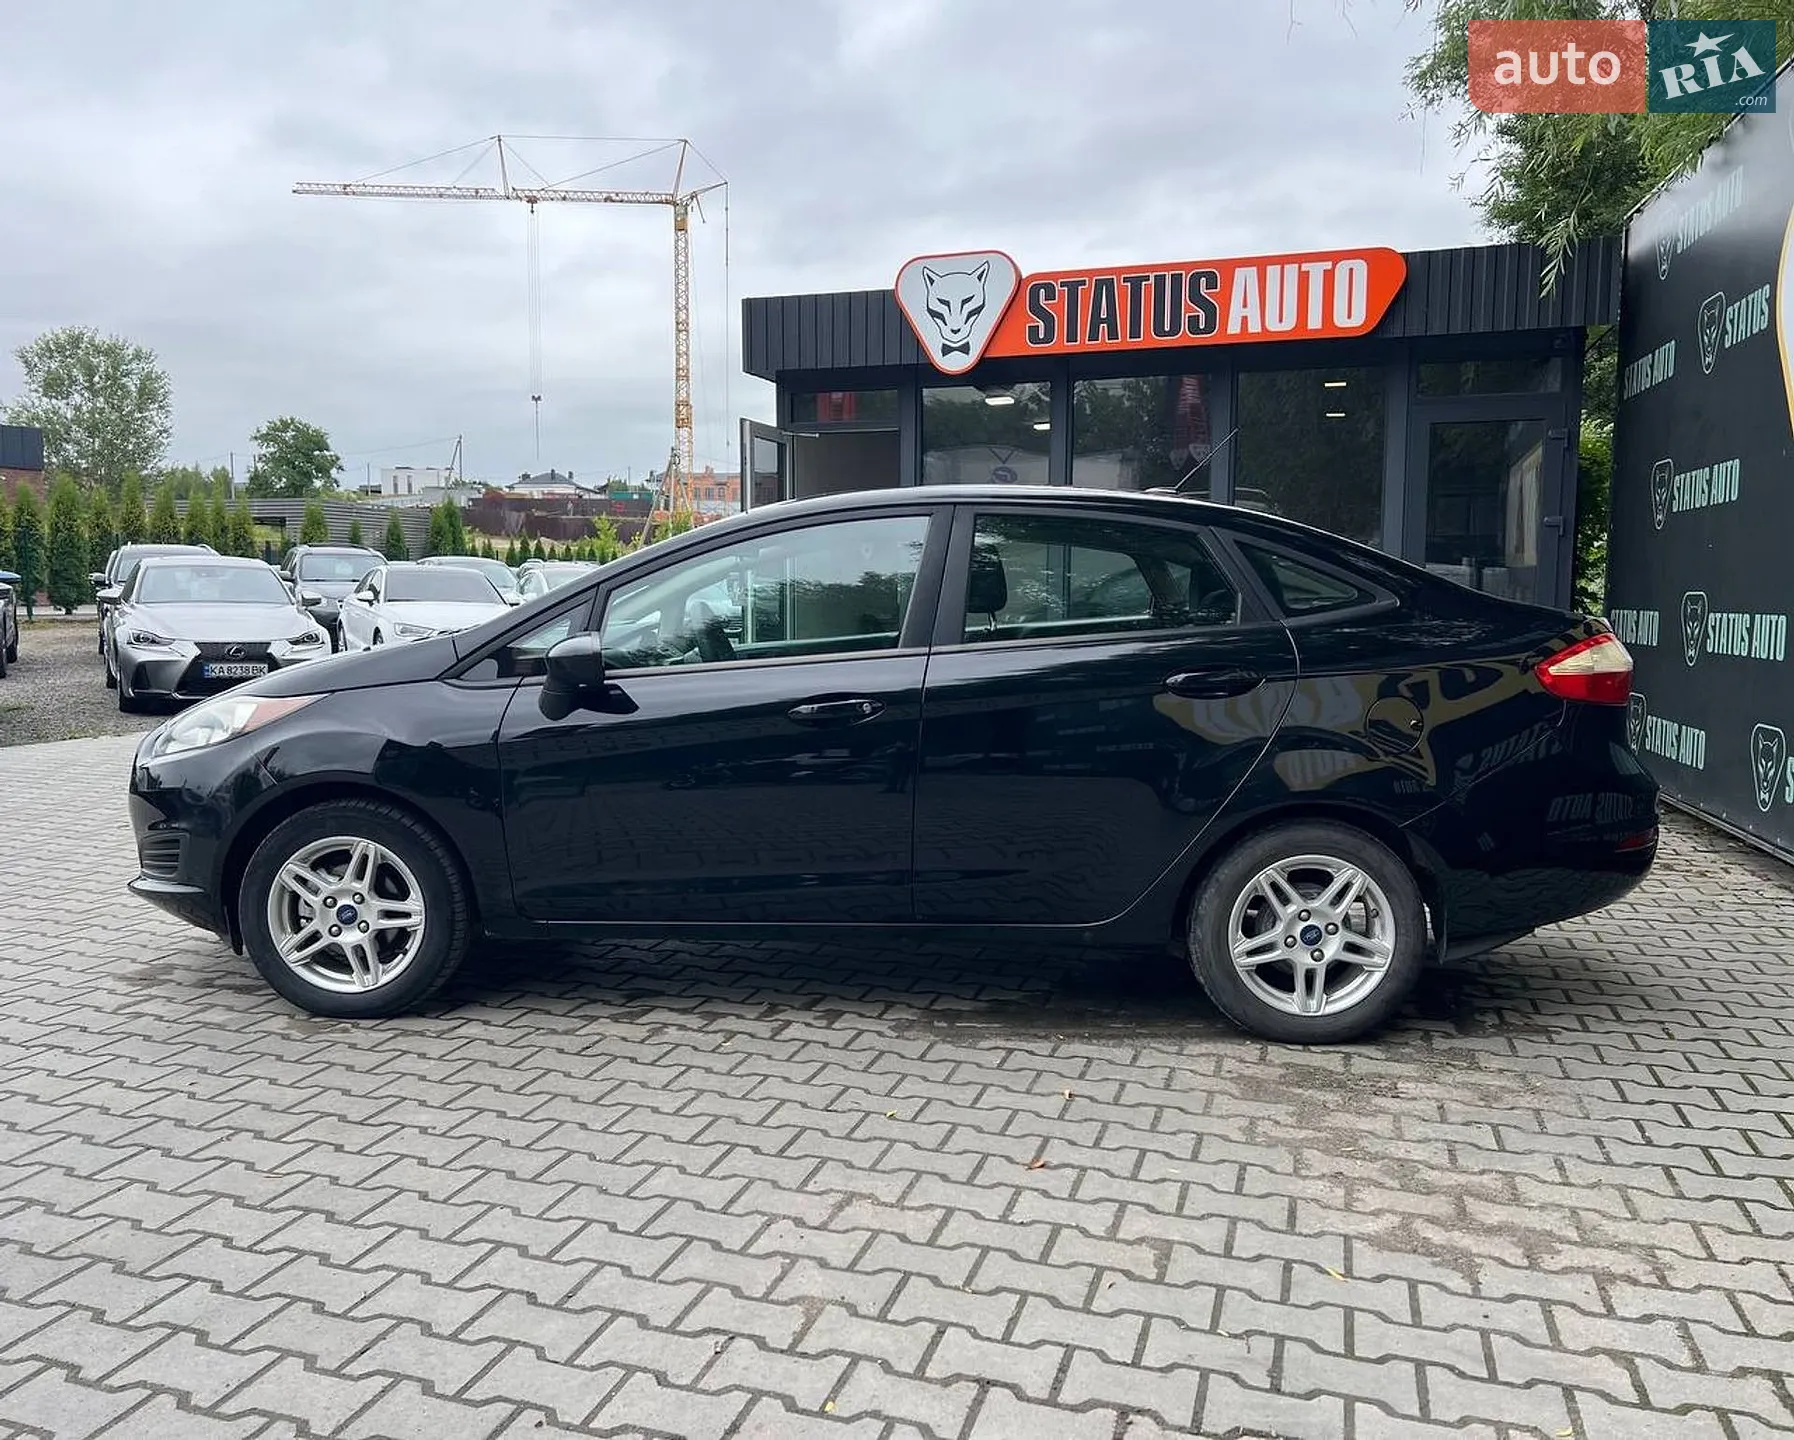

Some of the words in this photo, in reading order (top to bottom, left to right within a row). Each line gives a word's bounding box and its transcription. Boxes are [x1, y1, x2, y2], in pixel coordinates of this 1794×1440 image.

[1024, 270, 1221, 346] STATUS
[1226, 259, 1368, 335] AUTO
[1724, 283, 1771, 349] STATUS
[1622, 353, 1653, 400] STATUS
[1652, 339, 1676, 386] AUTO
[1672, 466, 1711, 513] STATUS
[1709, 458, 1741, 506] AUTO
[1637, 610, 1660, 646] AUTO
[1706, 612, 1750, 657] STATUS
[1750, 614, 1787, 662] AUTO
[210, 665, 225, 676] KA
[1645, 715, 1680, 761] STATUS
[1679, 724, 1706, 771] AUTO
